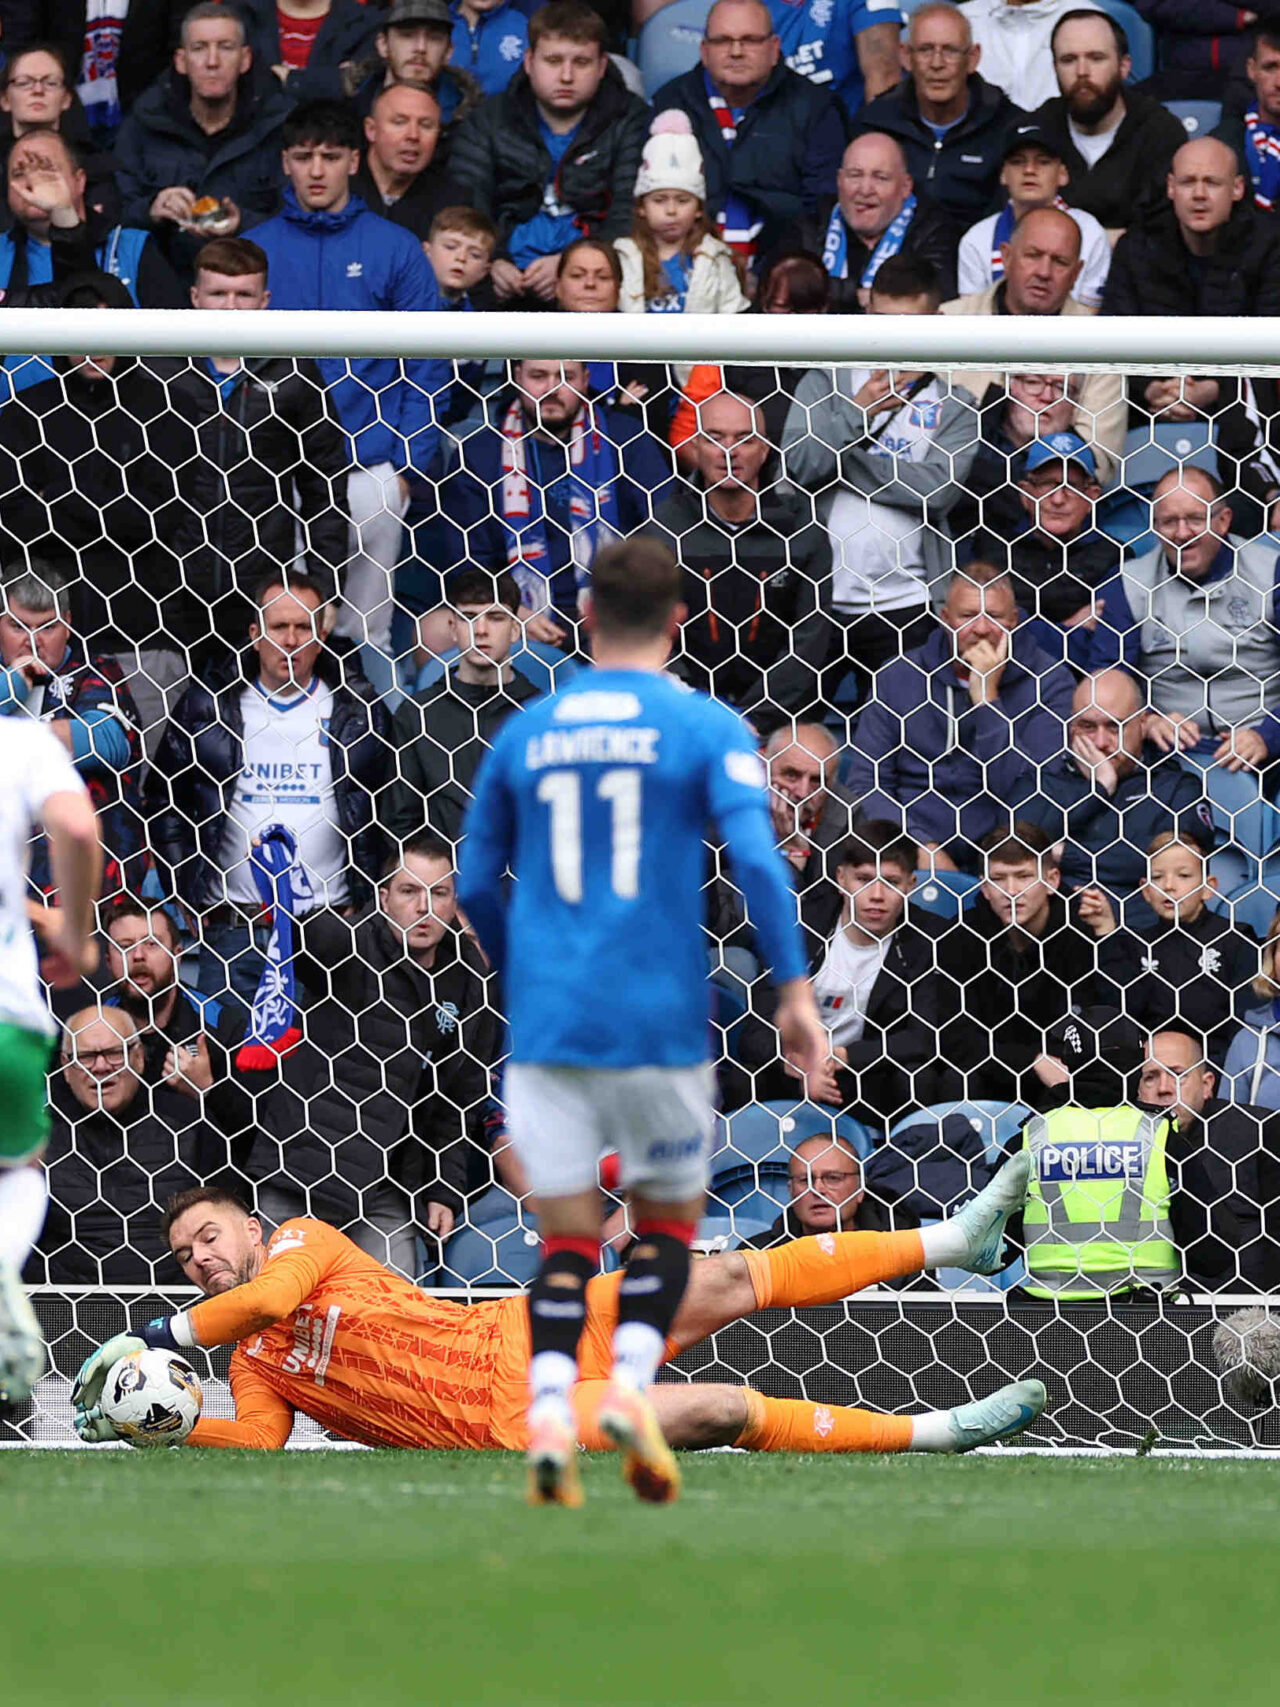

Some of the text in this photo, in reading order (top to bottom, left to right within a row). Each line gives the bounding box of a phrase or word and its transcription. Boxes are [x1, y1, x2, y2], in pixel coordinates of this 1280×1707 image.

[241, 763, 322, 778] UNIBET
[537, 769, 643, 904] 11
[1043, 1145, 1140, 1176] POLICE
